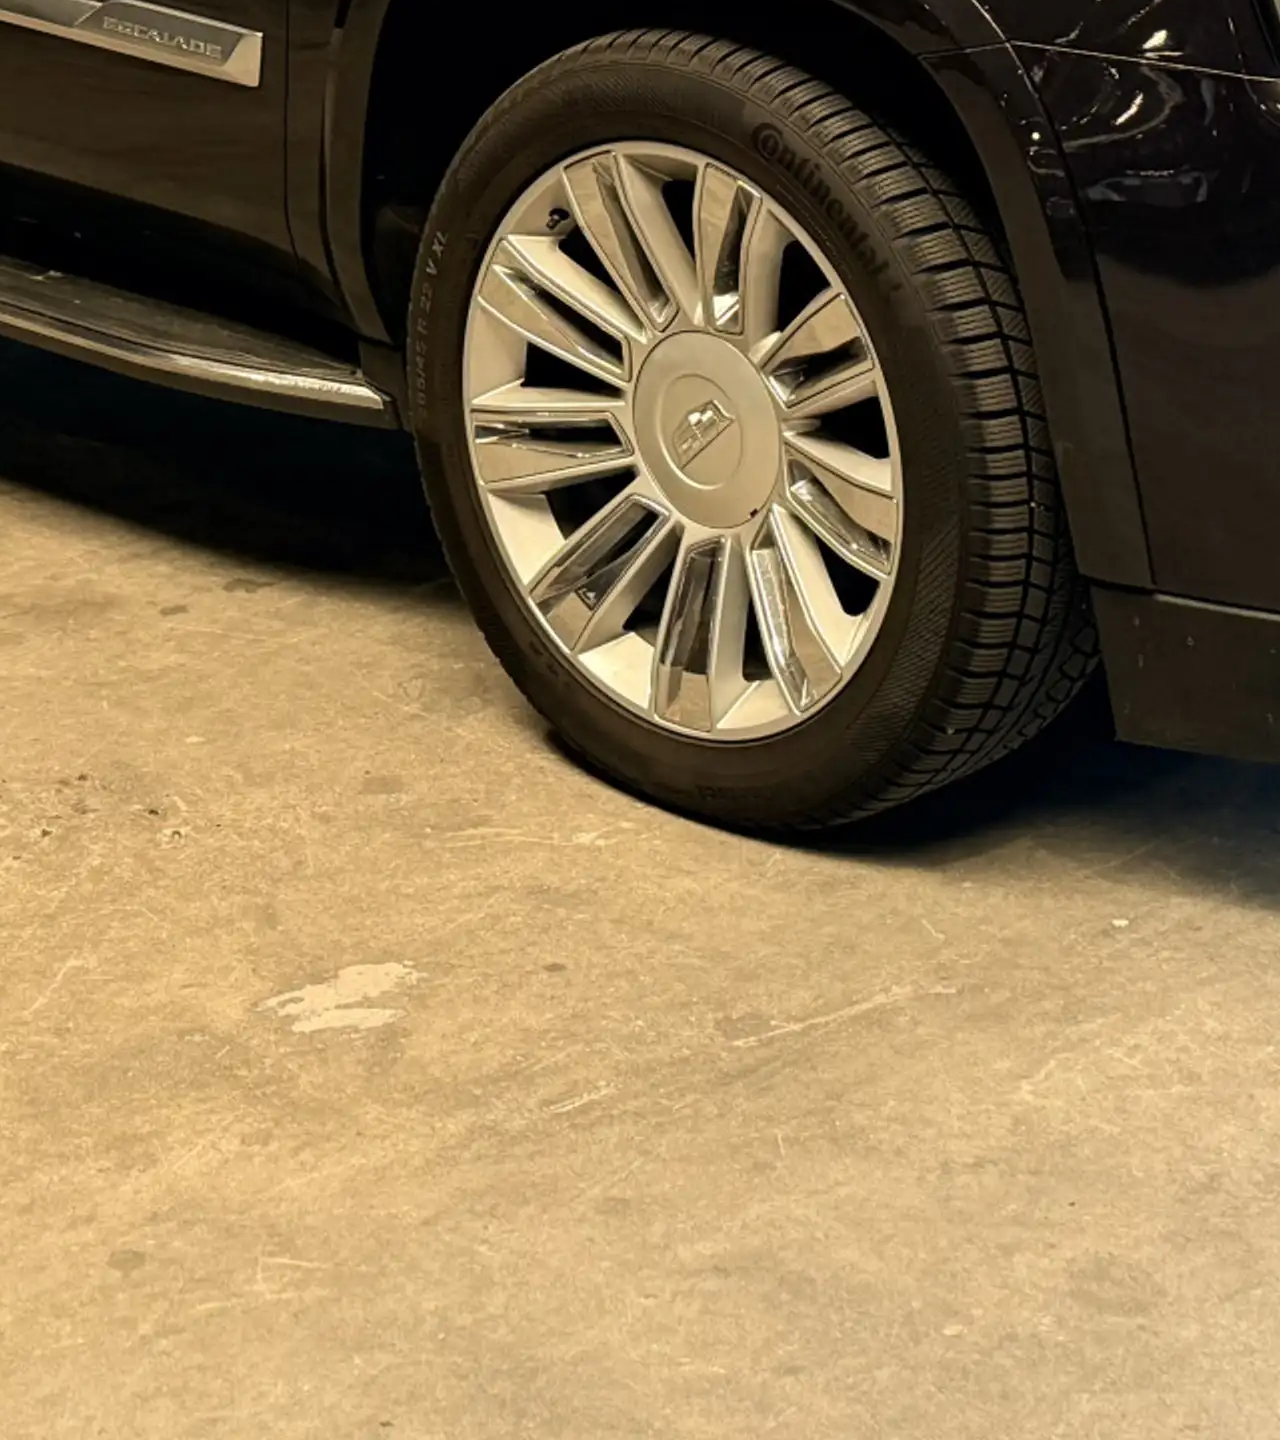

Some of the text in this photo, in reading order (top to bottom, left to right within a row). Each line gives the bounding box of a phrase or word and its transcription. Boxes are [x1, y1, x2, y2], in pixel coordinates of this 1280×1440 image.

[102, 15, 223, 60] ESCALADE
[751, 122, 889, 277] Continental
[431, 230, 449, 261] XL
